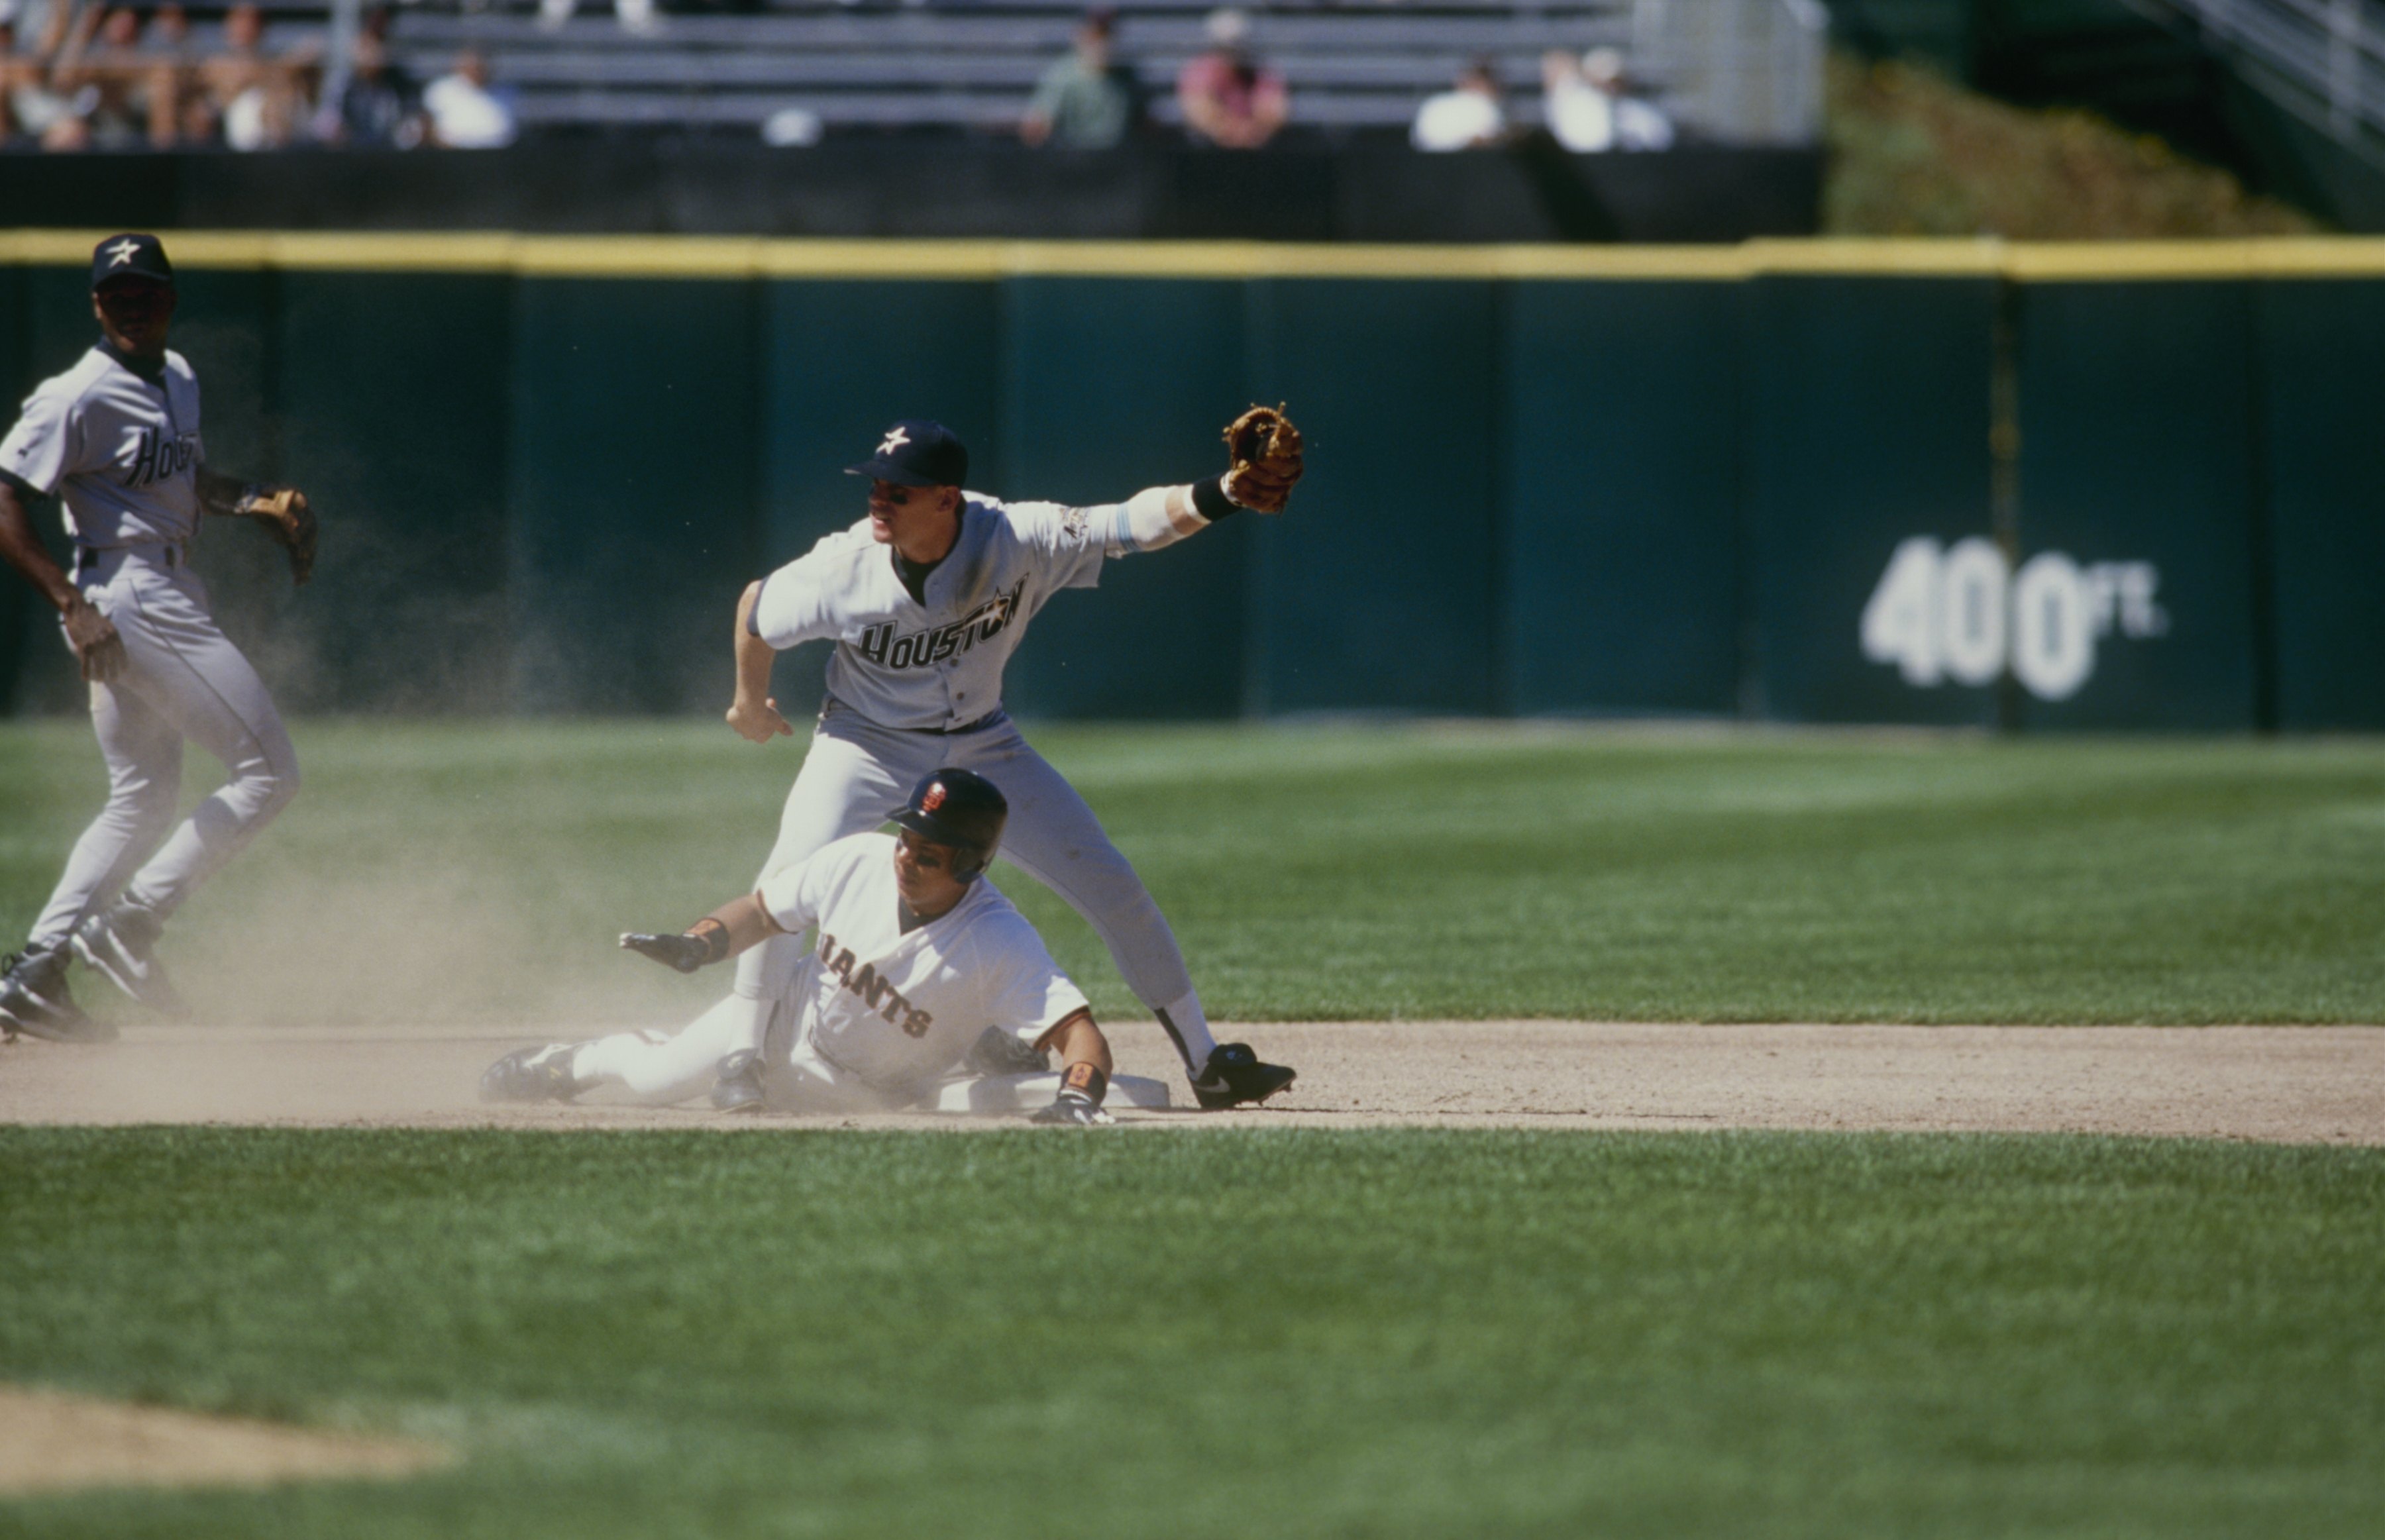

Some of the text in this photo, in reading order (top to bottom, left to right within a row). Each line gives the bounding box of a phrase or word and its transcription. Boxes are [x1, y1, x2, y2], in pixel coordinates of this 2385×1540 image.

[859, 573, 1030, 669] HOUSTON
[1860, 537, 2092, 701] 400
[821, 934, 932, 1038] IANTS
